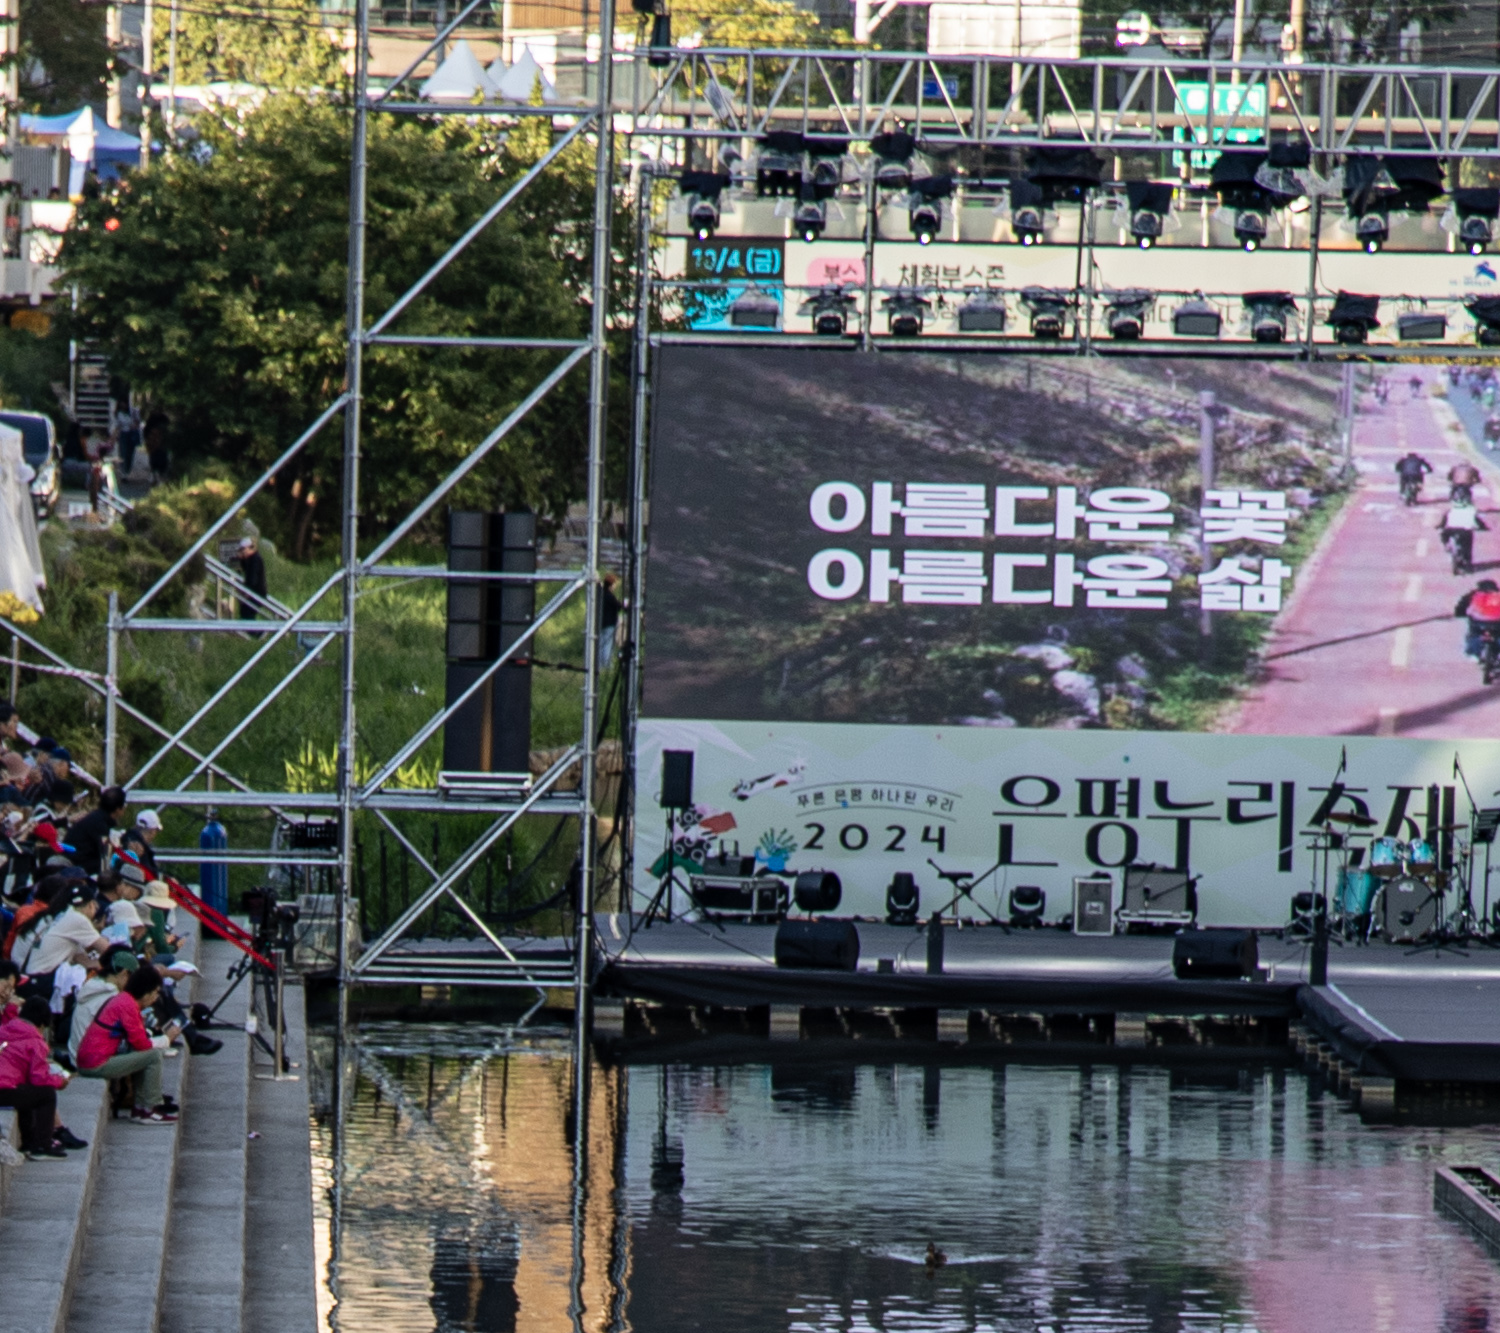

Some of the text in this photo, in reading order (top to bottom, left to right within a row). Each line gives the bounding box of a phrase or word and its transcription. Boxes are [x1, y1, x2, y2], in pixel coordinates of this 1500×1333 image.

[809, 481, 1290, 544] 아름다운 꽃
[807, 548, 1292, 612] 아름다운 삶
[926, 794, 955, 812] 우리
[992, 774, 1456, 872] 은평누리축제
[803, 822, 946, 853] 2024
